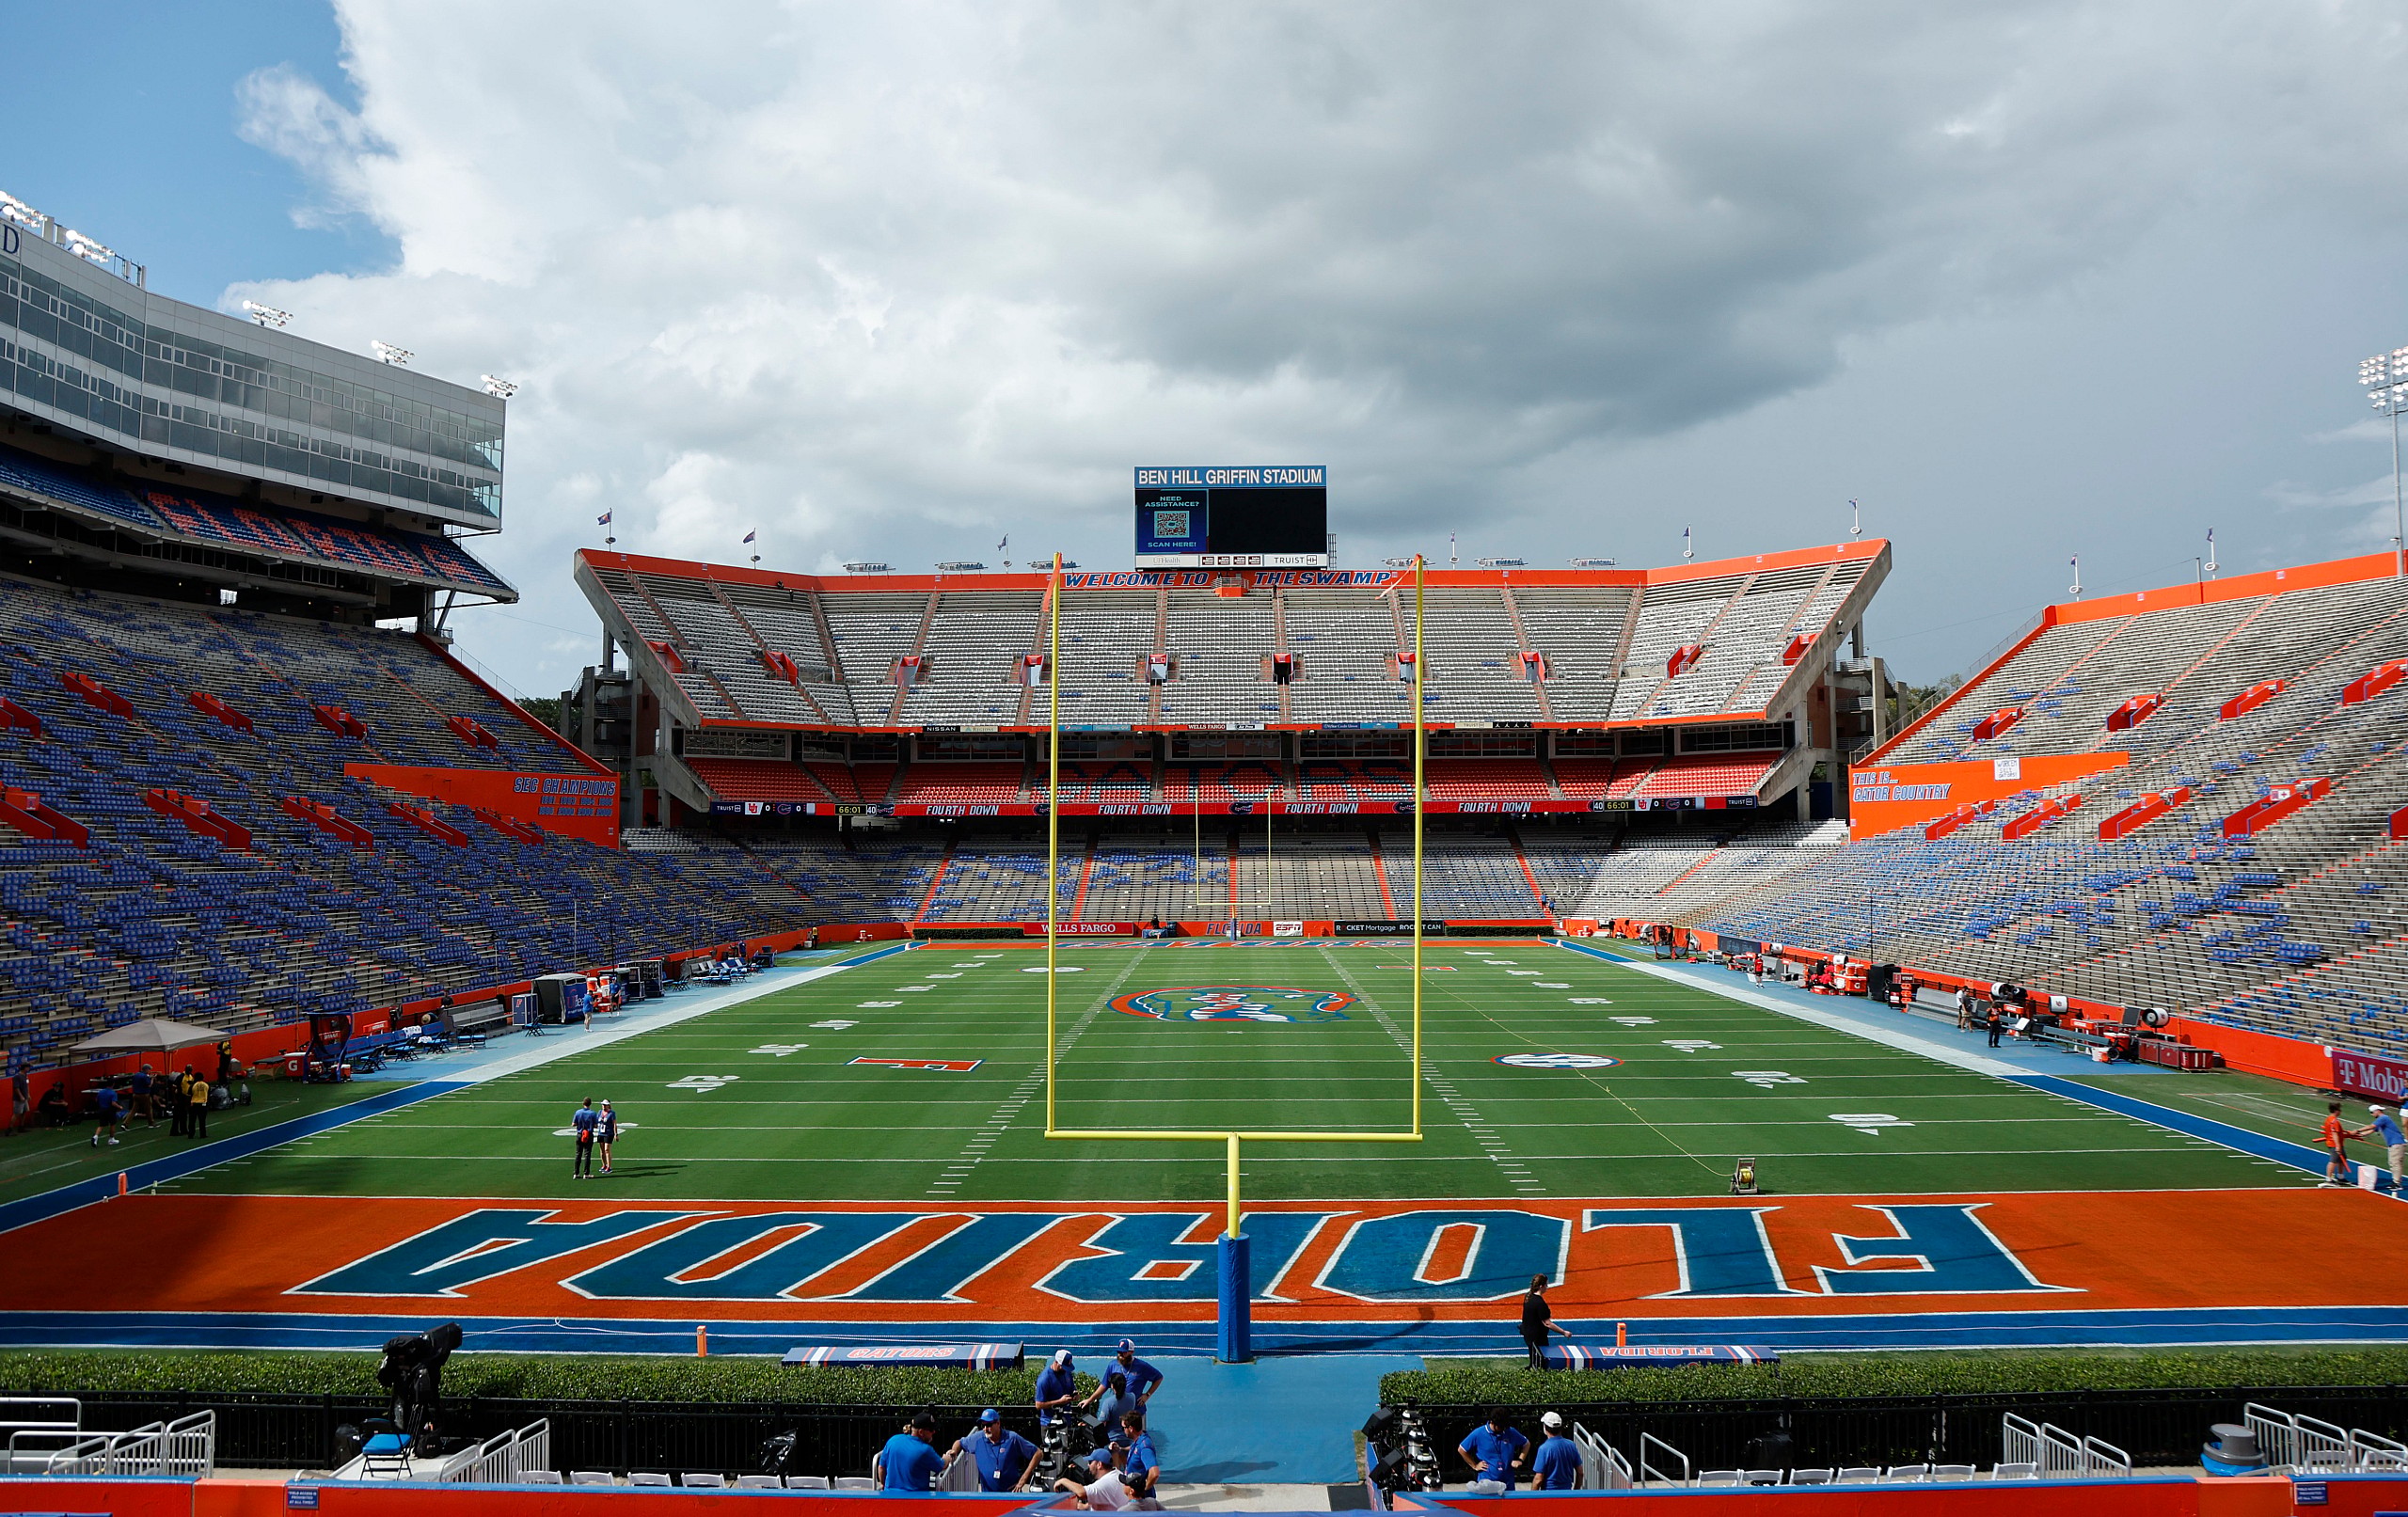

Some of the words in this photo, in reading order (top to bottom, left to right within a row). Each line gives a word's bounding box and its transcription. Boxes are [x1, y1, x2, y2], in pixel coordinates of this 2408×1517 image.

[1138, 470, 1167, 484] BEN
[1171, 470, 1202, 484] HILL
[1206, 469, 1259, 484] GRIFFIN
[1263, 468, 1322, 484] STADIUM
[1065, 572, 1176, 587] WELCOME
[1182, 572, 1210, 585] TO
[1254, 571, 1298, 585] THE
[1299, 571, 1392, 585] SWAMP
[1853, 772, 1876, 785] THIS
[514, 777, 539, 792] SEC
[543, 778, 616, 796] CHAMPIONS
[1853, 786, 1891, 802] GATOR
[1893, 783, 1952, 800] COUNTRY
[867, 805, 876, 814] 40
[926, 805, 966, 815] FOURTH
[969, 805, 999, 815] DOWN
[1098, 804, 1138, 814] FOURTH
[1142, 804, 1172, 814] DOWN
[1285, 803, 1325, 814] FOURTH
[1328, 803, 1358, 814] DOWN
[1458, 803, 1497, 812] FOURTH
[1501, 802, 1531, 812] DOWN
[1593, 801, 1603, 810] 40
[1041, 924, 1077, 932] WELLS
[1080, 924, 1116, 932] FARGO
[516, 999, 523, 1008] F
[288, 1060, 298, 1071] G
[282, 1203, 2088, 1304] FLORIDA
[847, 1348, 956, 1358] GATORS
[1600, 1347, 1715, 1357] FLORIDA
